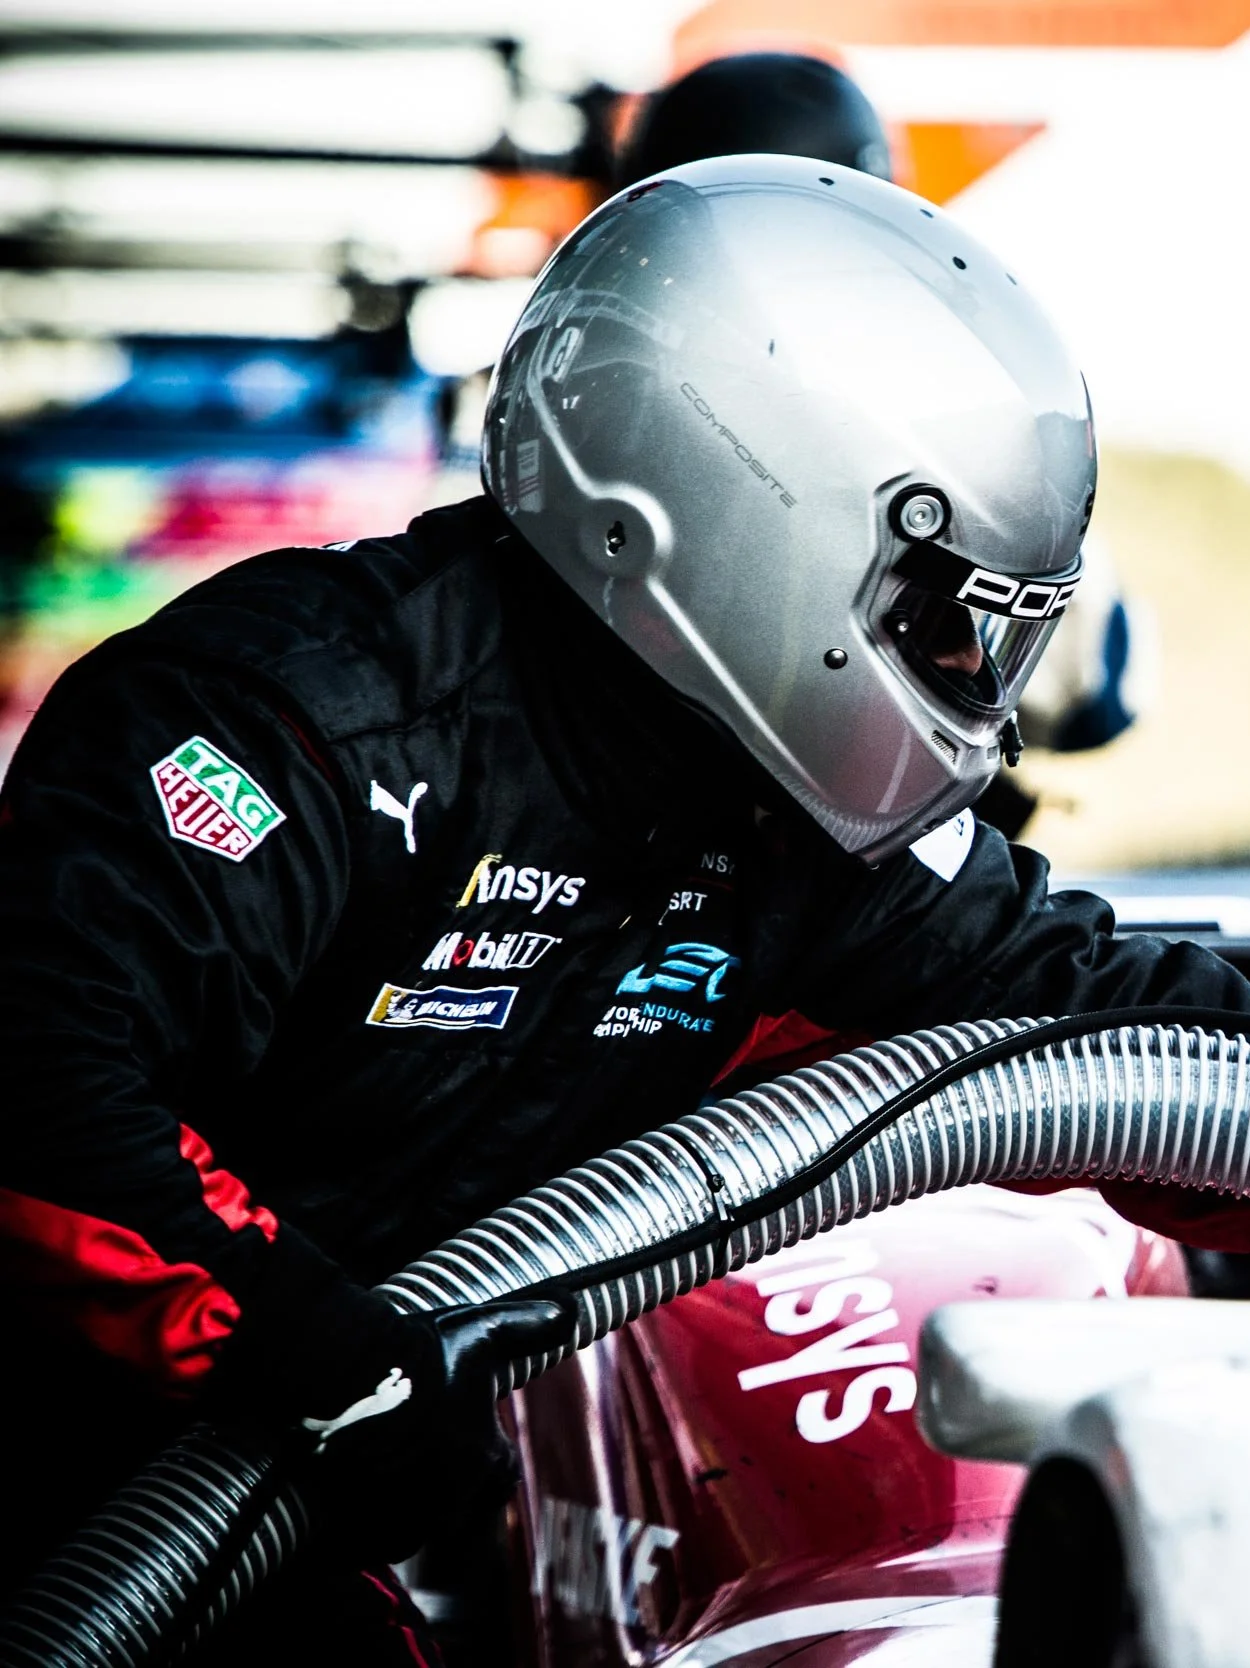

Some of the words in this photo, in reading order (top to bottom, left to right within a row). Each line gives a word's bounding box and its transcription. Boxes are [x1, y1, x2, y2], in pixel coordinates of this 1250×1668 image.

[680, 382, 797, 508] COMPOSITE
[157, 764, 250, 853] HEUER
[187, 744, 273, 830] TAG
[456, 854, 586, 914] Ansys
